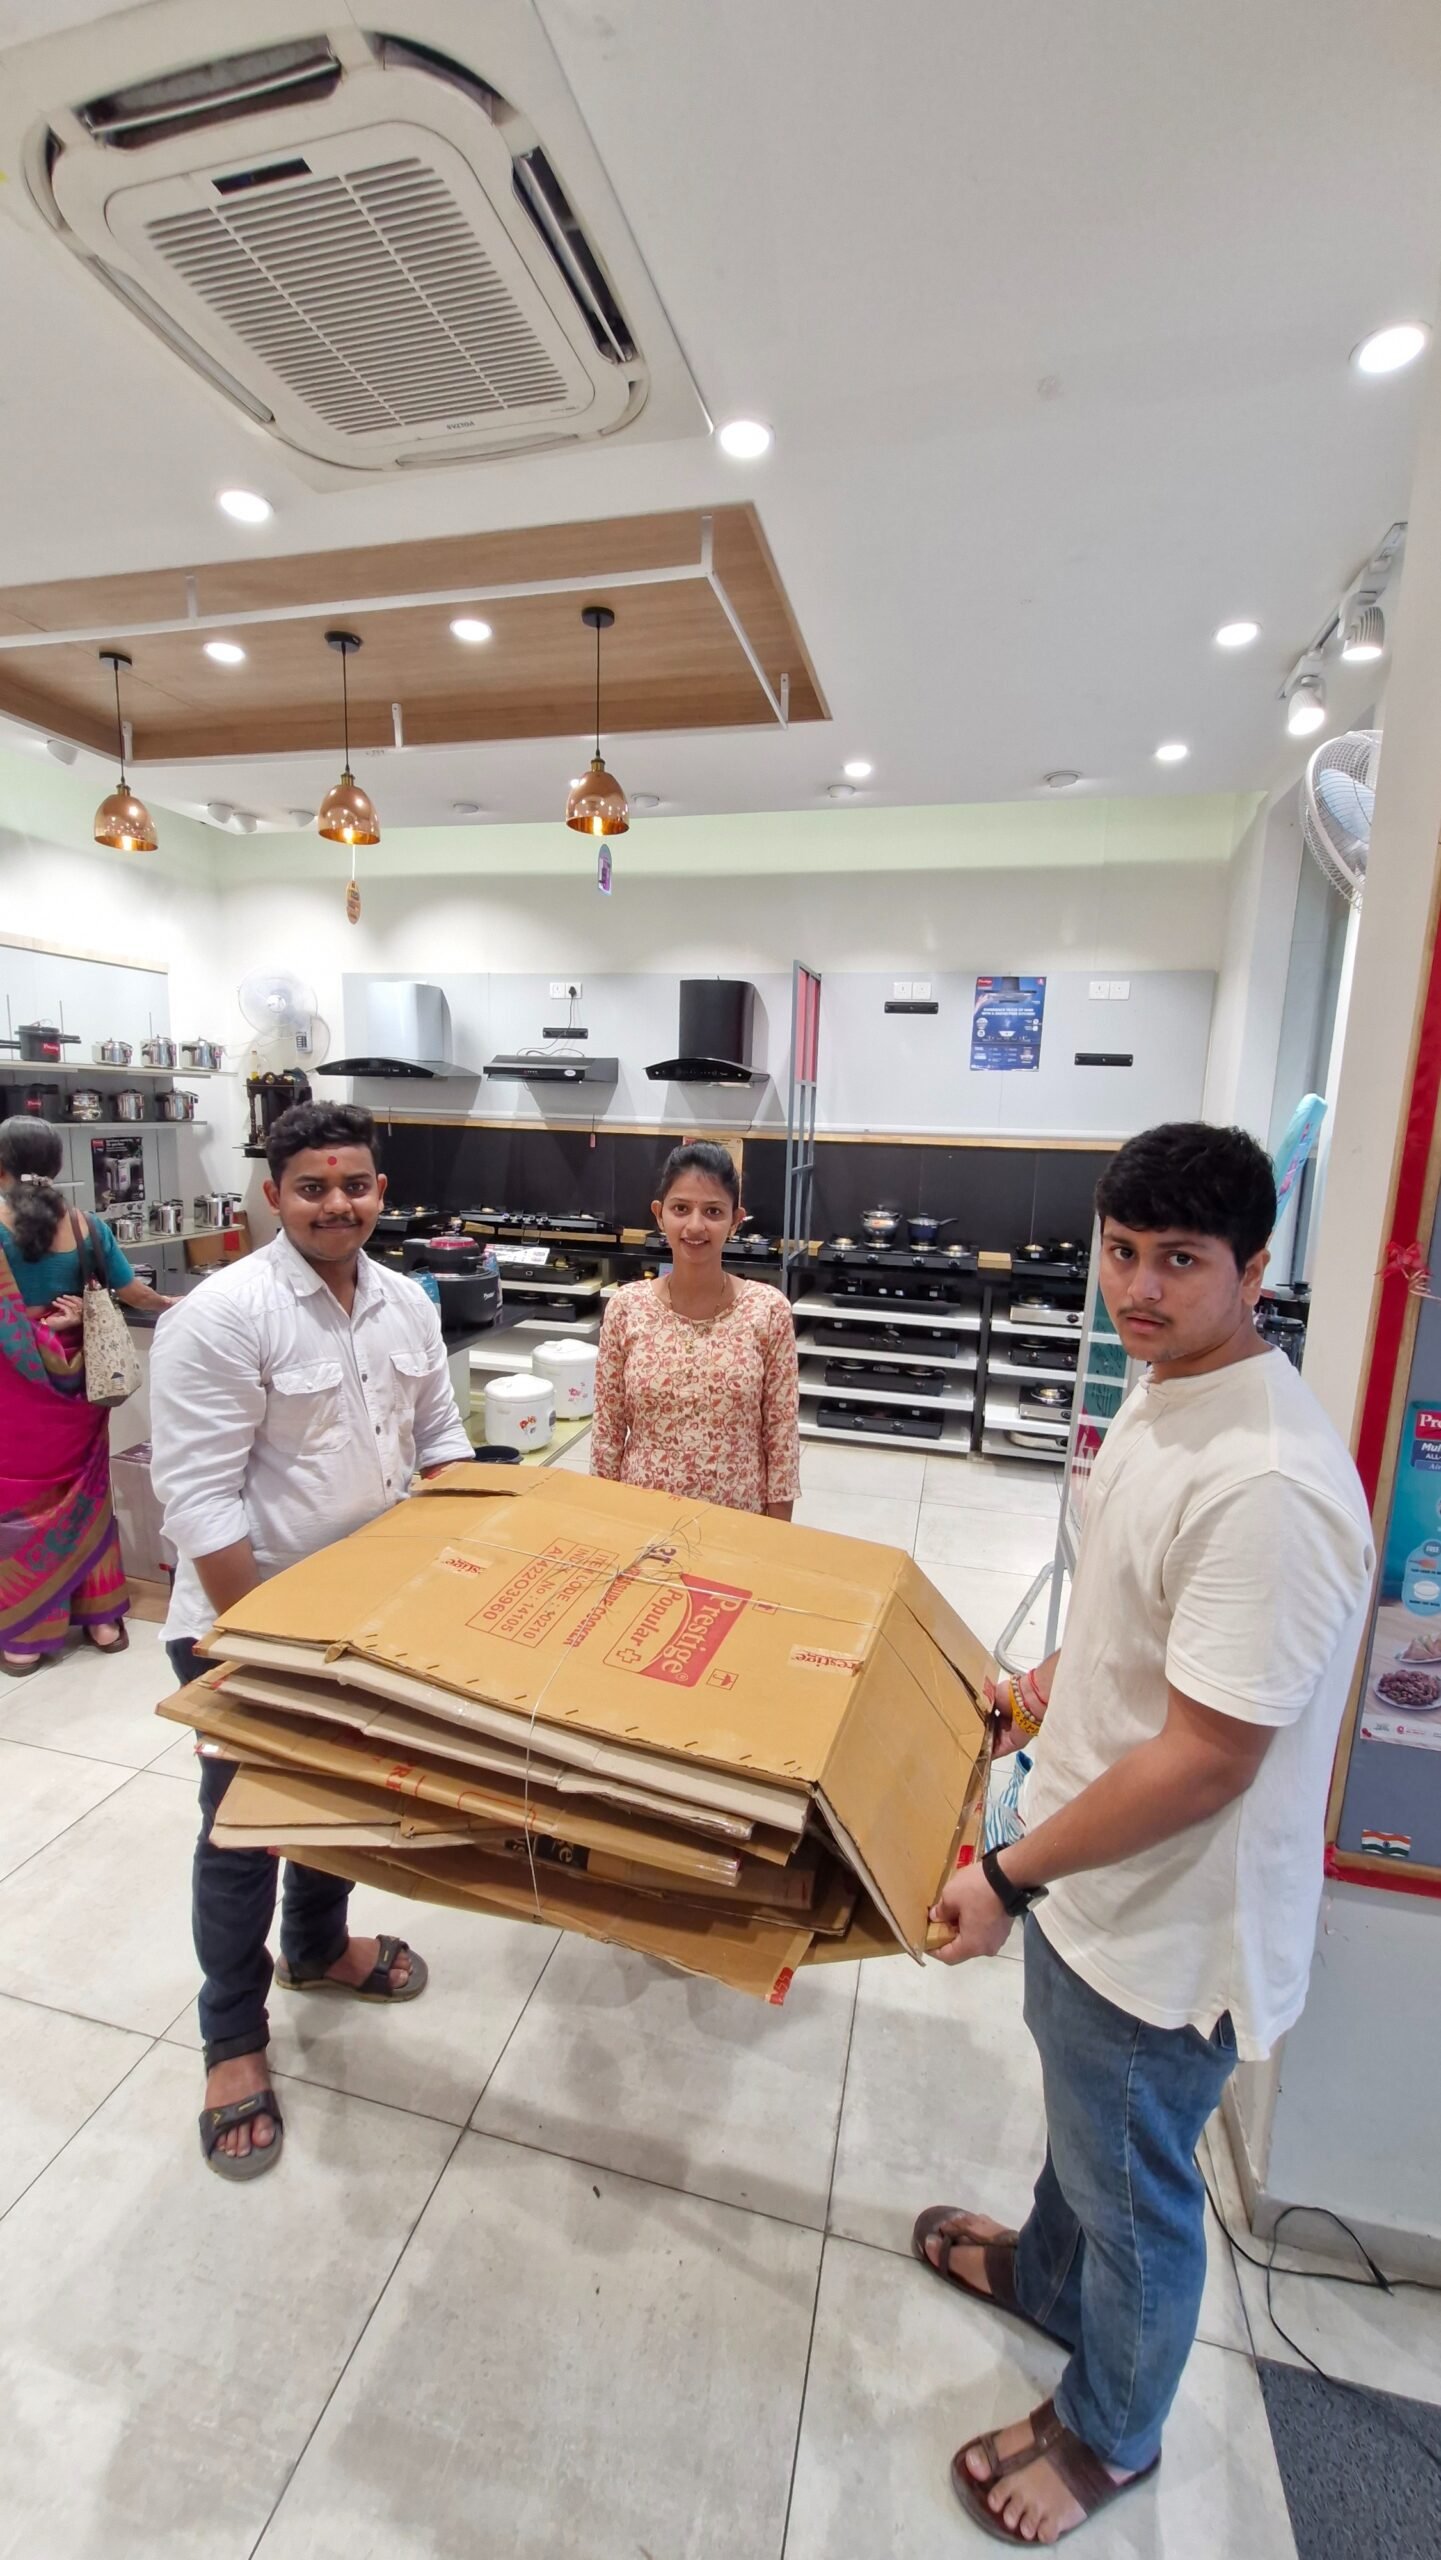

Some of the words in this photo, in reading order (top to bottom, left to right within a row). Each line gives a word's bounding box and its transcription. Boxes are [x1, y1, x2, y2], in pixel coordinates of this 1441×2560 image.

[446, 420, 476, 430] VOLTAS
[445, 1558, 481, 1575] stige
[558, 1548, 590, 1574] INDX
[500, 1603, 535, 1633] 14105
[630, 1588, 684, 1647] Popular
[661, 1595, 740, 1674] Prestige
